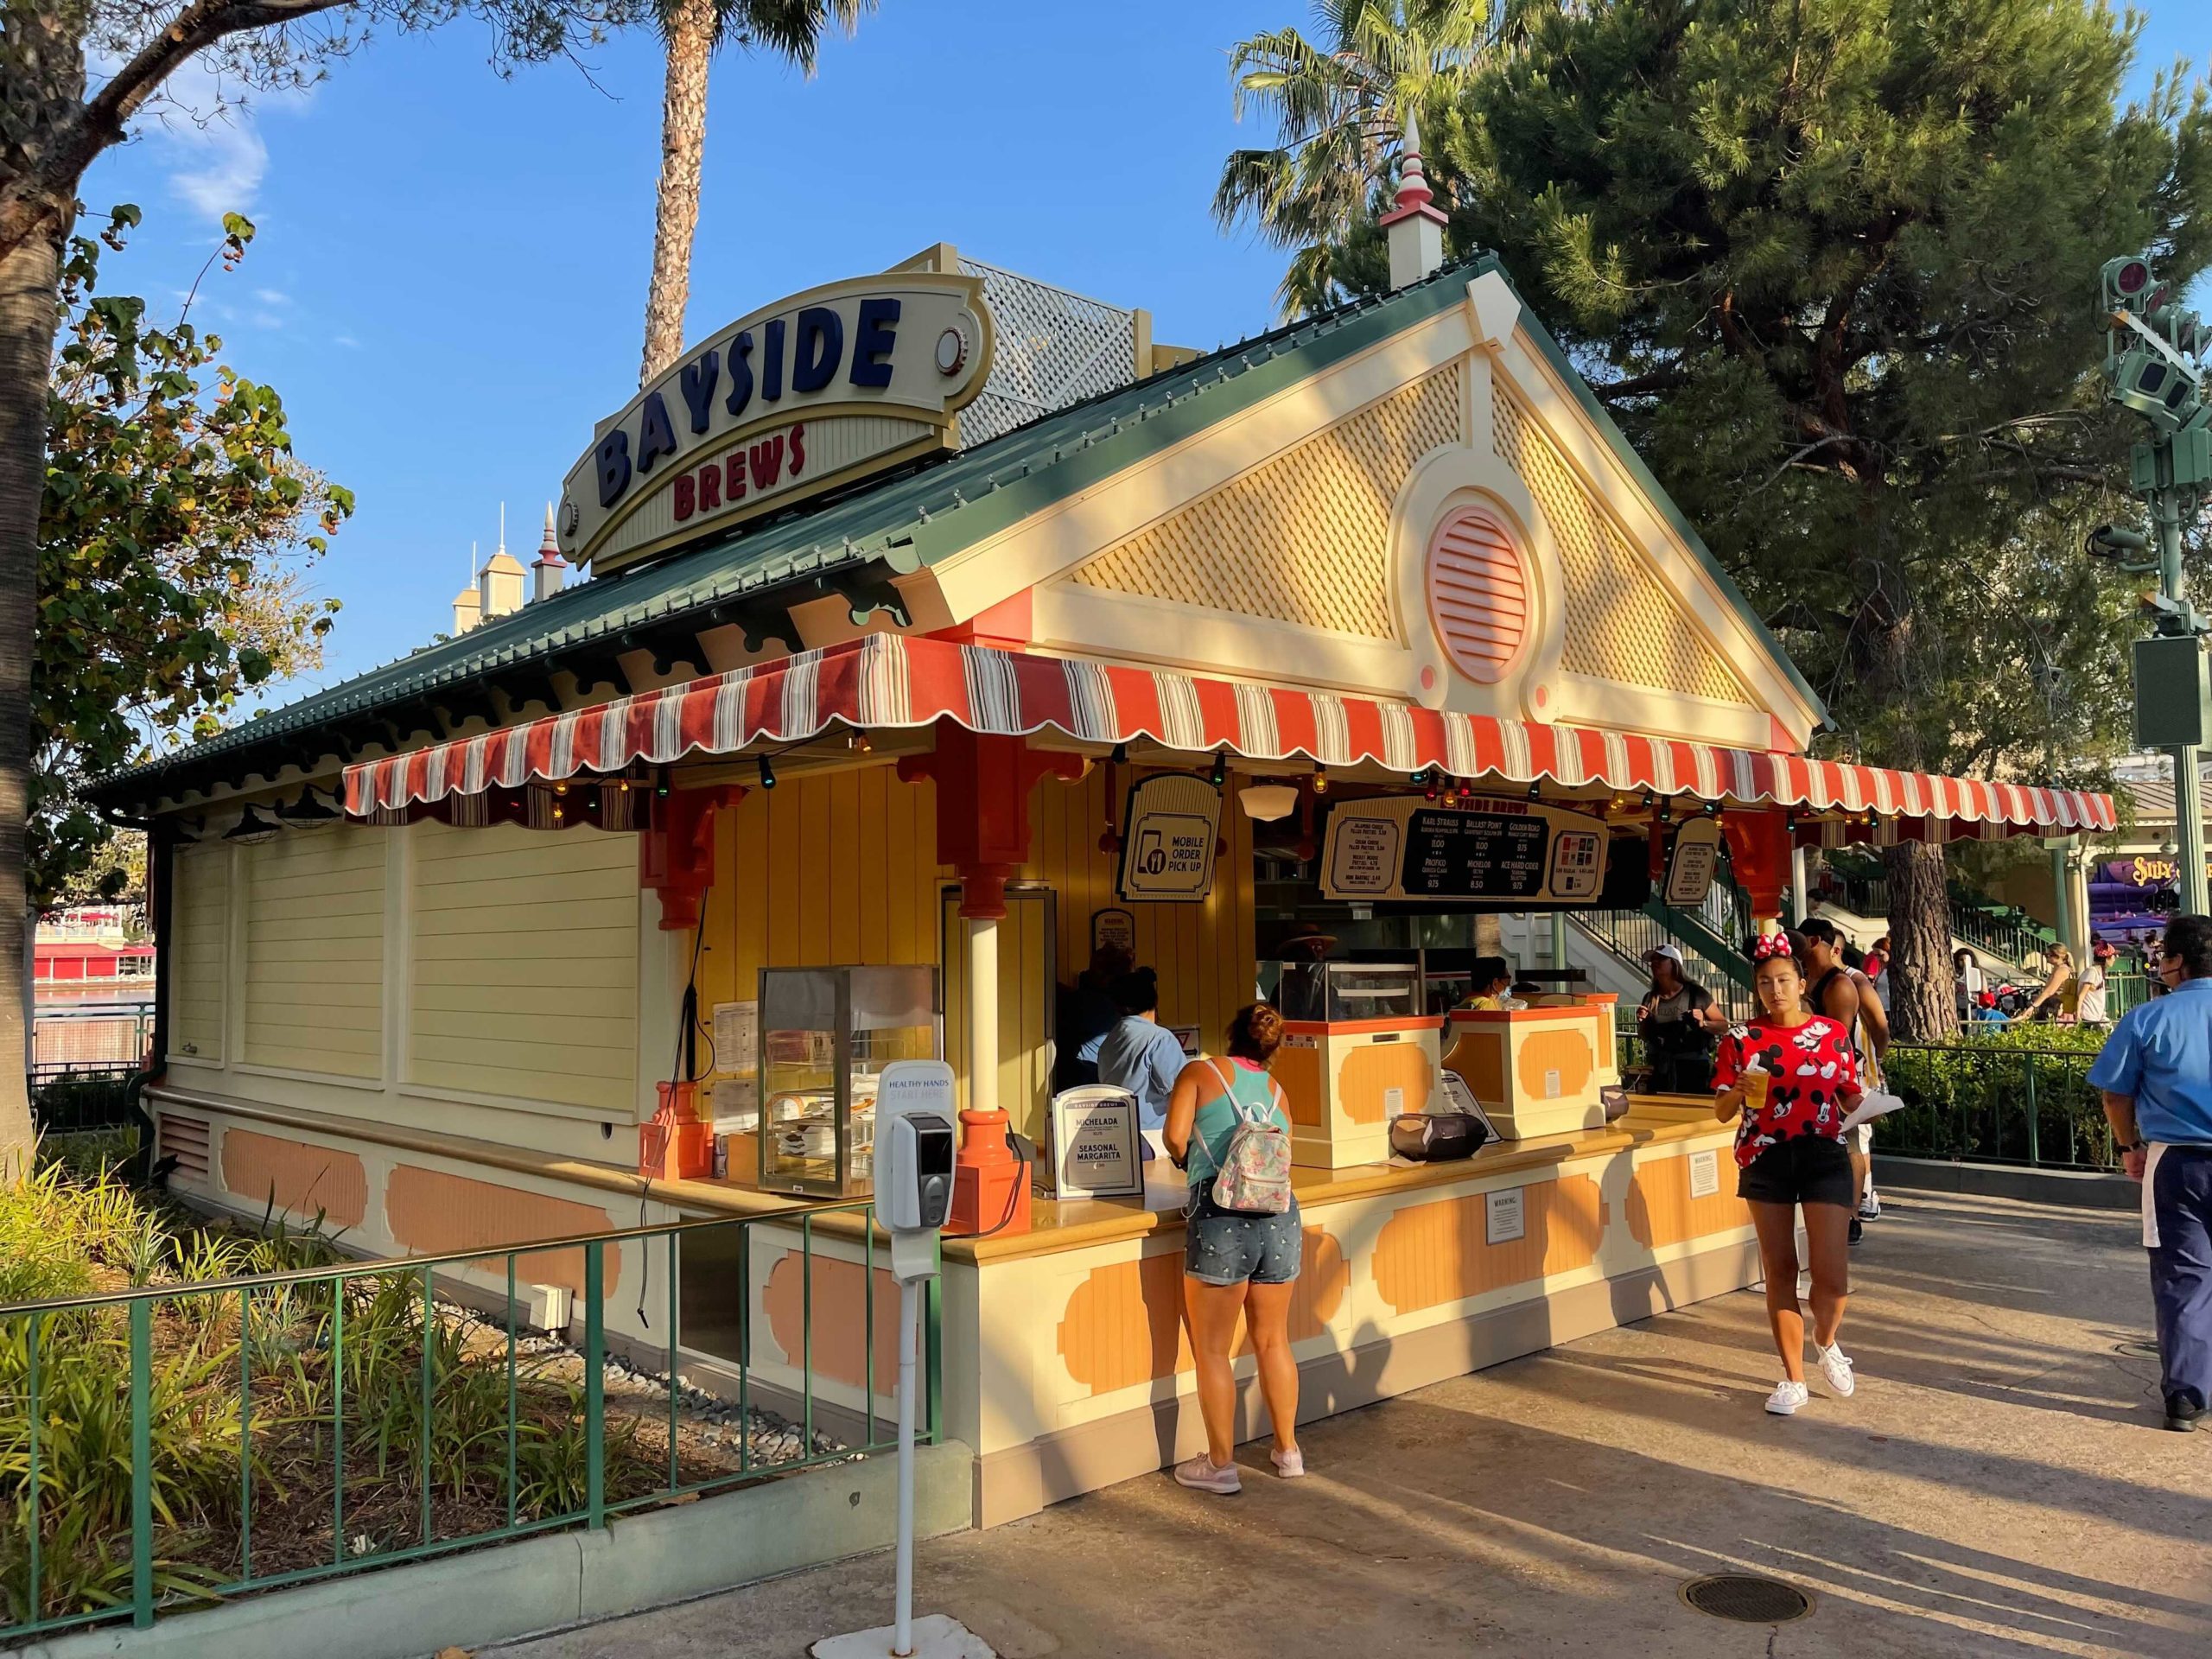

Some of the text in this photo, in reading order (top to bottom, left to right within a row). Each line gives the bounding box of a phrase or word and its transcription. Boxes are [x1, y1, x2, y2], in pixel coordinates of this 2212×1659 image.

[595, 298, 901, 508] BAYSIDE
[674, 424, 805, 521] BREWS
[1440, 796, 1490, 812] YSIDE
[1422, 817, 1459, 827] KARL STRAUSS
[1465, 819, 1503, 830] BALLAST POINT
[1173, 836, 1205, 848] MOBILE
[1172, 849, 1201, 860] ORDER
[1168, 861, 1202, 872] PICK UP
[890, 1090, 944, 1100] START HERE
[1076, 1118, 1118, 1127] MICHELADA
[1079, 1143, 1118, 1153] SEASONAL
[1077, 1152, 1121, 1160] MARGARITA
